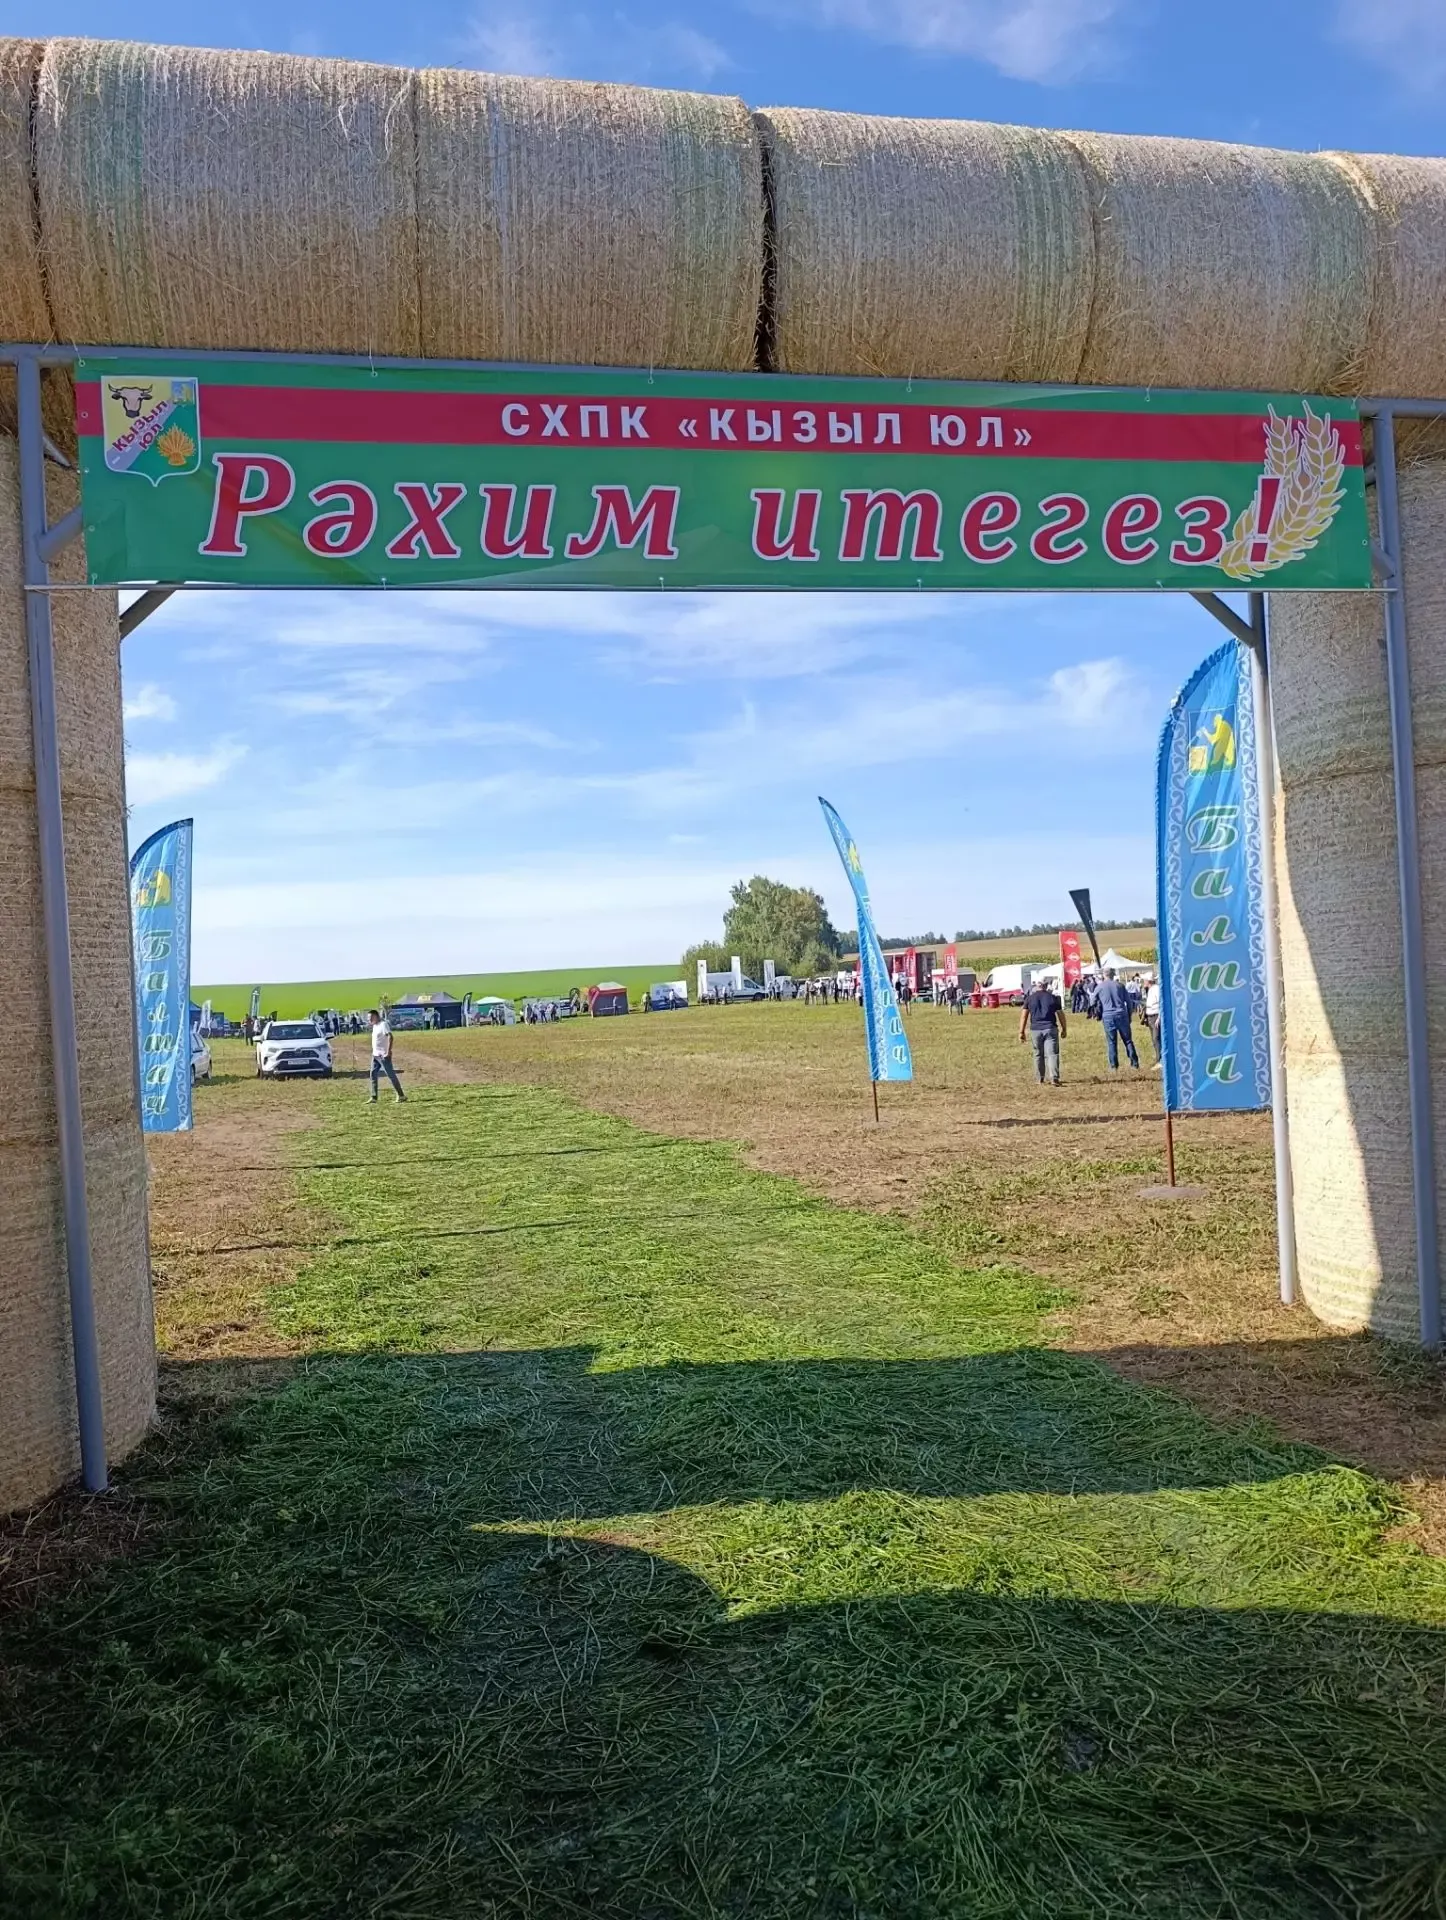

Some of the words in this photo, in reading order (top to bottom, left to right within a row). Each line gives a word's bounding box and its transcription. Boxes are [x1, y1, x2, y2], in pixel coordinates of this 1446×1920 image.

[112, 400, 168, 451] КЫЗЫЛ
[138, 423, 162, 450] ЮЛ
[501, 404, 650, 439] СХПК
[679, 409, 902, 446] «КЫЗЫЛ
[930, 413, 1033, 448] ЮЛ»
[199, 453, 682, 559] Рәхим
[751, 475, 1284, 565] итегез!
[1186, 806, 1245, 1083] Балтач
